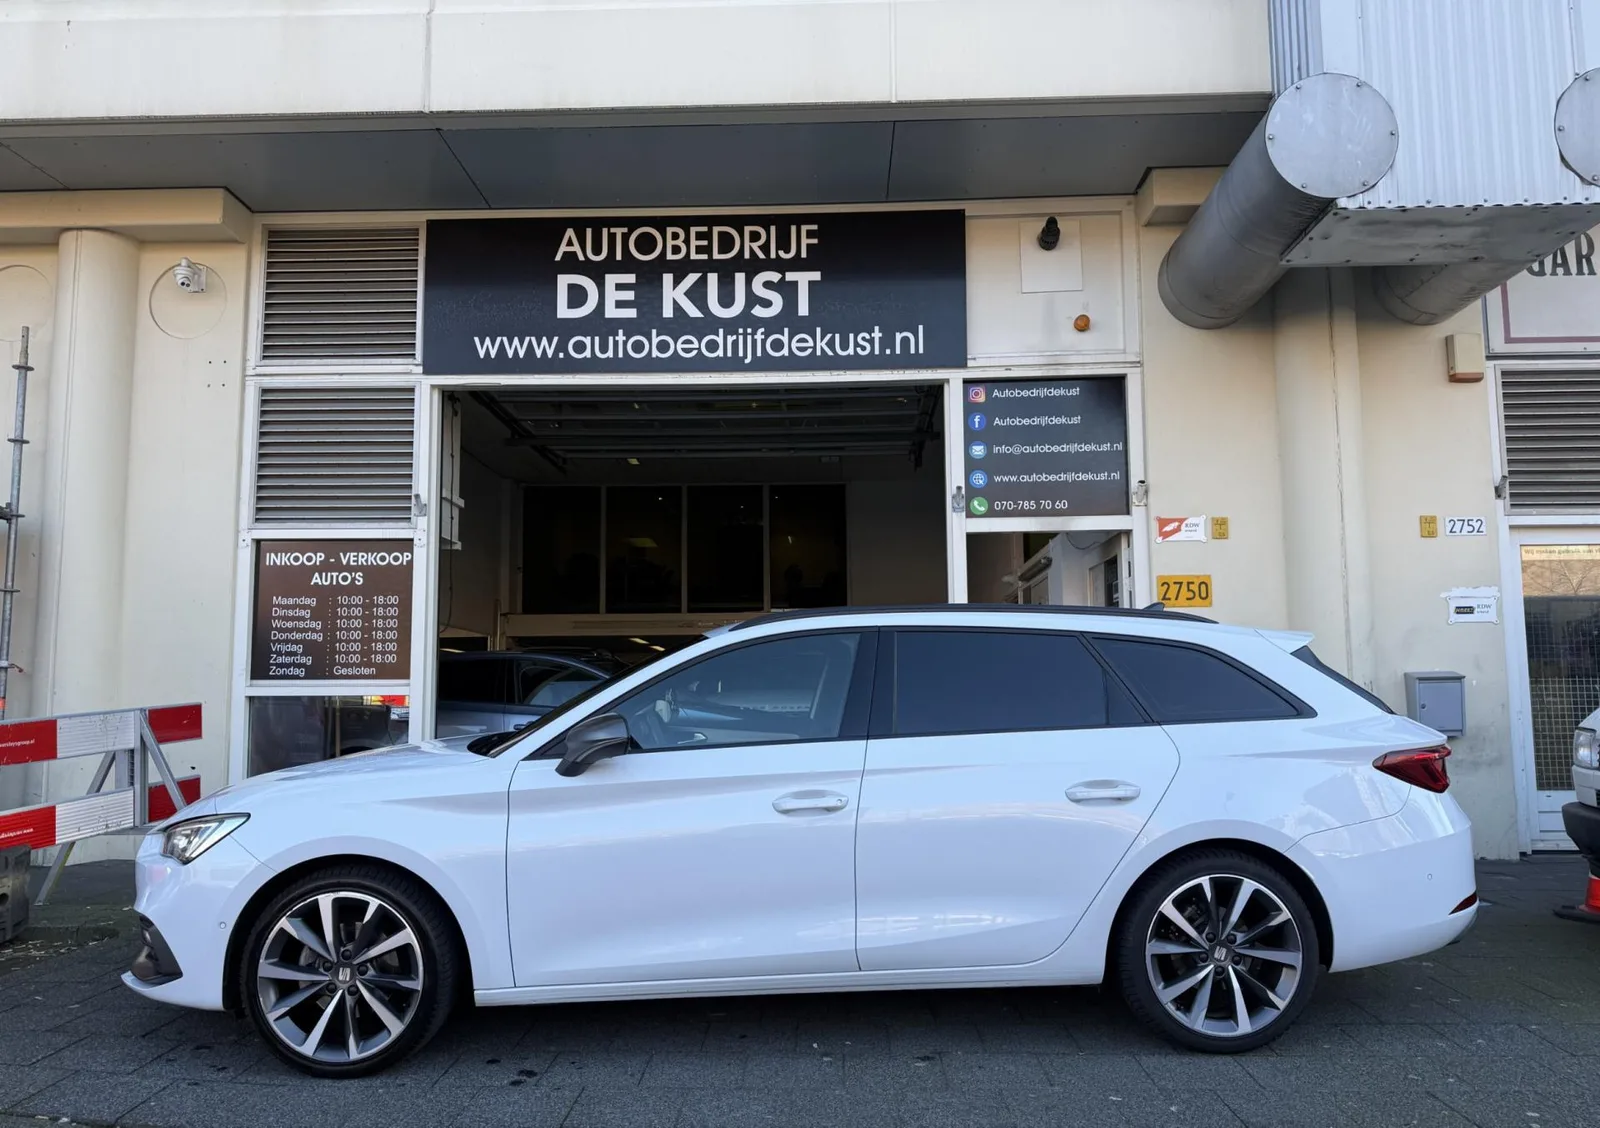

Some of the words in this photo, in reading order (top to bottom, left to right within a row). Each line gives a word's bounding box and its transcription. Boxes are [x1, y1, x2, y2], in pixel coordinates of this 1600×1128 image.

[555, 225, 818, 261] AUTOBEDRIJF
[557, 274, 637, 318] DE
[663, 271, 821, 318] KUST
[474, 325, 923, 363] www.autobedrijfdekust.nl
[992, 387, 1079, 398] Autobedrijfdekust
[994, 416, 1080, 426] Autobedrijfdekust
[994, 442, 1122, 454] info@autobedrijfdekust.nl
[994, 471, 1119, 482] www.autobedrijfdekust.nl
[995, 501, 1036, 510] 070-785
[1040, 500, 1051, 509] 70
[1055, 500, 1067, 509] 60
[1449, 519, 1483, 533] 2752
[266, 553, 324, 565] INKOOP
[340, 552, 411, 565] VERKOOP
[311, 572, 363, 585] AUTO'S
[1161, 581, 1208, 601] 2750
[273, 596, 316, 606] Maandag
[337, 596, 363, 604] 10:00
[373, 596, 398, 604] 18:00
[273, 608, 310, 617] Dinsdag
[337, 607, 362, 616] 10:00
[373, 607, 398, 616] 18:00
[272, 620, 321, 629] Woensdag
[337, 619, 362, 628] 10:00
[372, 619, 398, 627] 18:00
[271, 631, 323, 641] Donderdag
[336, 631, 361, 639] 10:00
[372, 631, 397, 639] 18:00
[271, 643, 302, 653] Vrijdag
[336, 642, 361, 651] 10:00
[372, 642, 397, 651] 18:00
[270, 655, 312, 664] Zaterdag
[335, 654, 360, 663] 10:00
[371, 654, 396, 663] 18:00
[269, 666, 305, 676] Zondag
[334, 666, 375, 675] Gesloten
